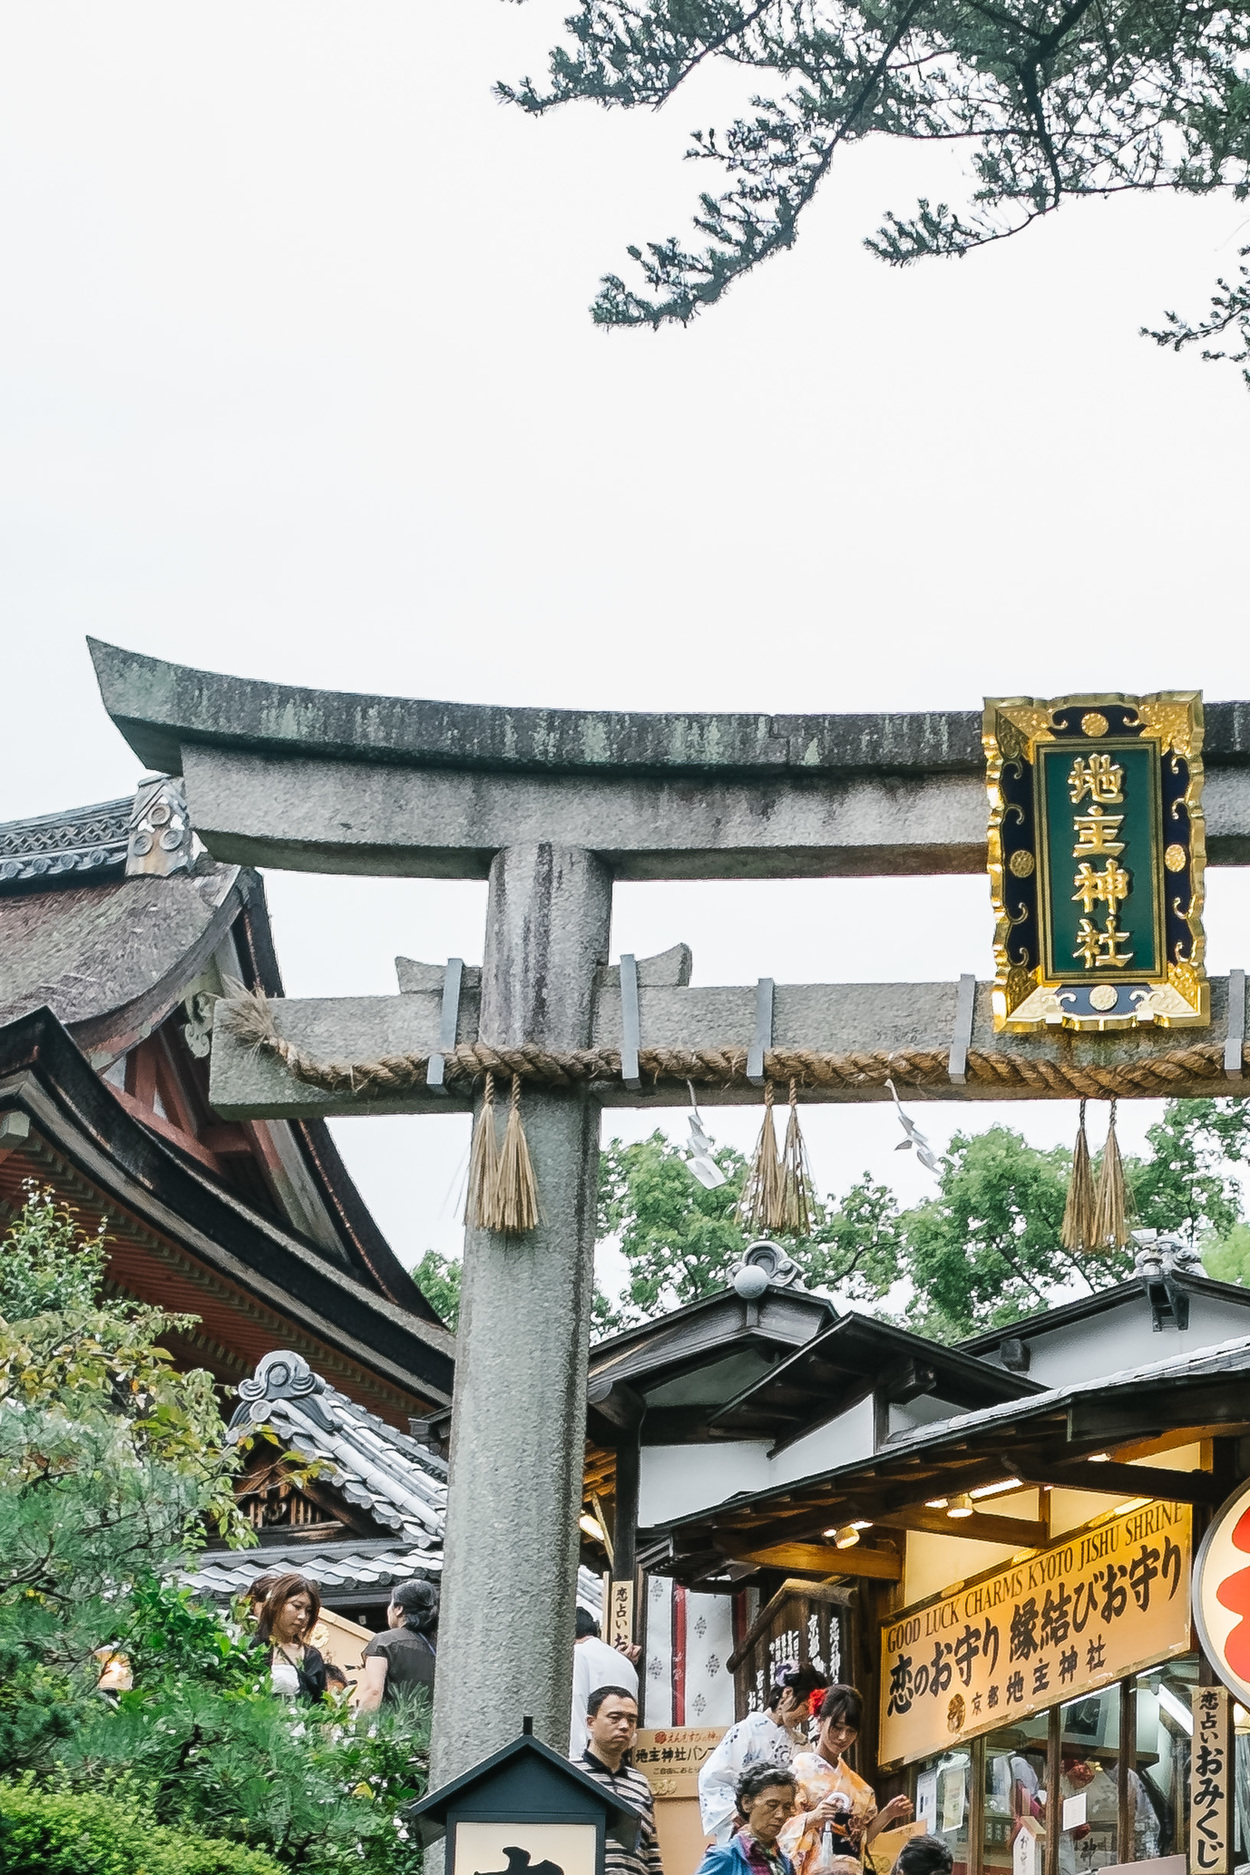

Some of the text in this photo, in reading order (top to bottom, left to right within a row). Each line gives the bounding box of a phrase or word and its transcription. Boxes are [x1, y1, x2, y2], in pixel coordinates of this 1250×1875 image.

[1067, 752, 1133, 969] 地主神社
[887, 1501, 1183, 1653] GOOD LUCK CHARMS KYOTO JISHU SHRINE
[887, 1535, 1182, 1716] 恋のお守り 縁結びお守り
[1193, 1690, 1225, 1868] 恋占いおみくじ
